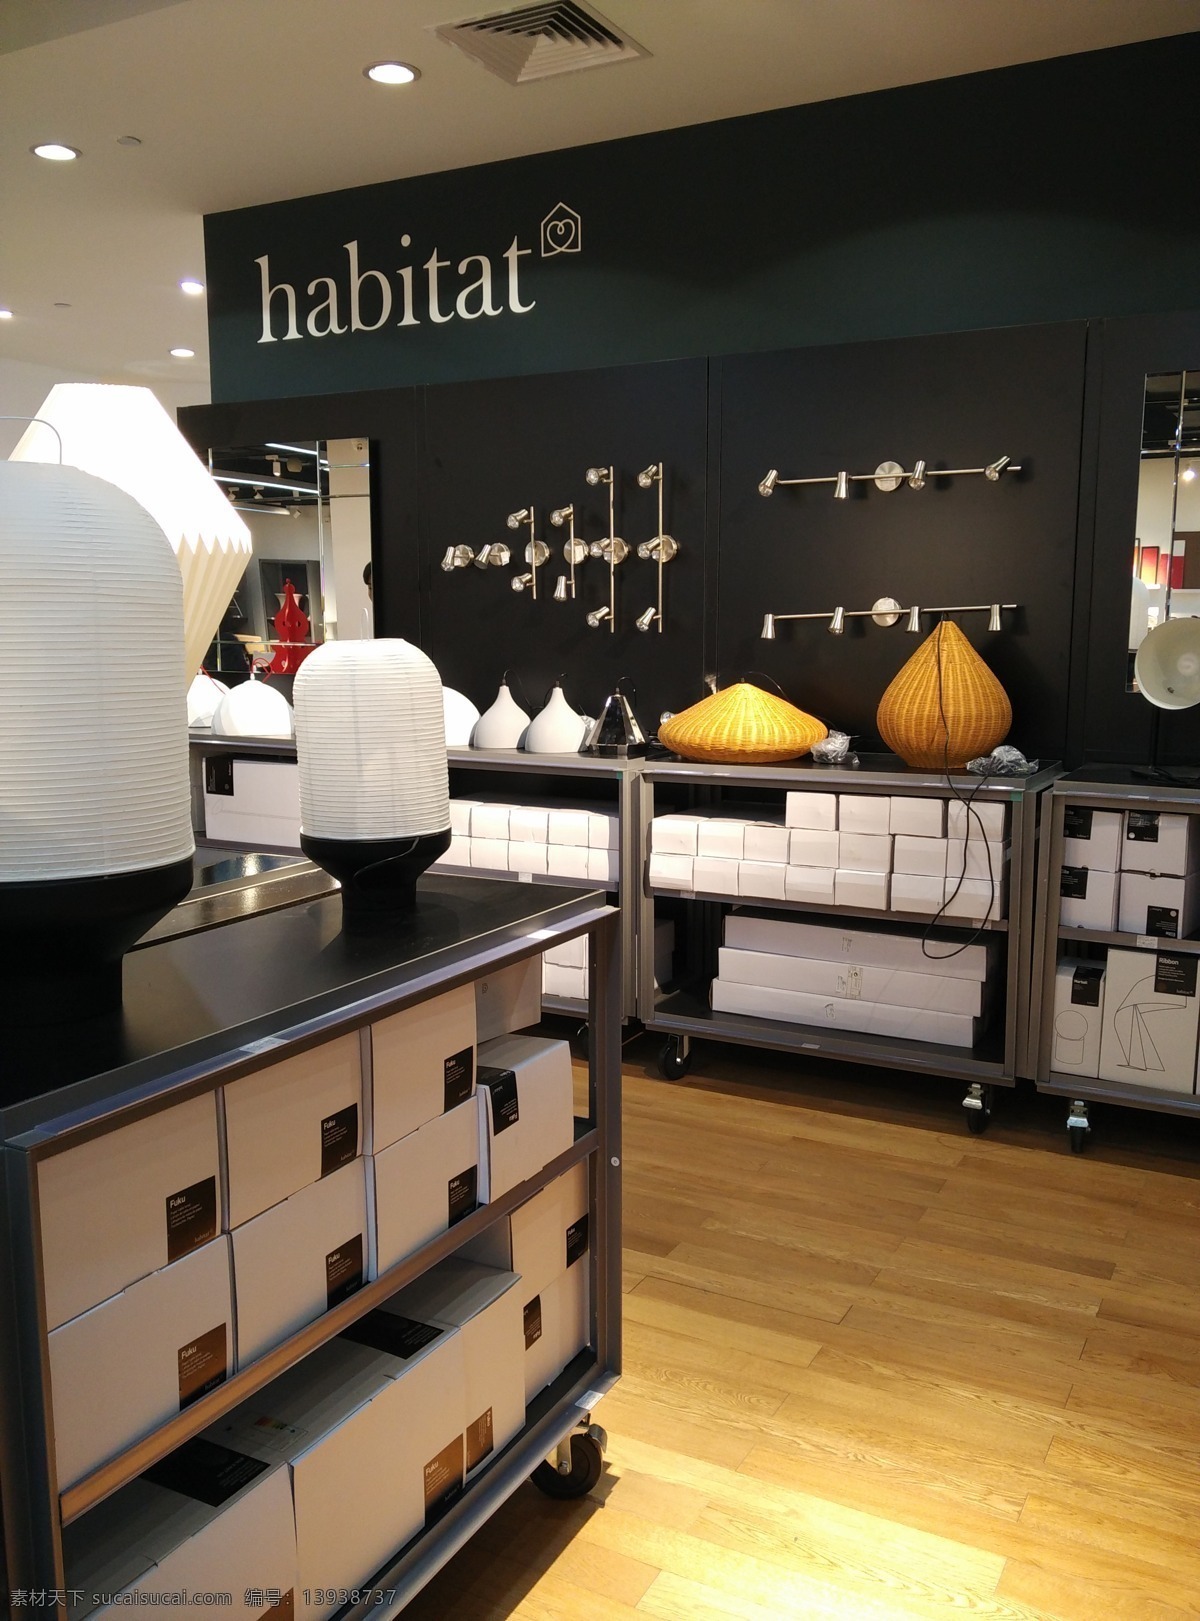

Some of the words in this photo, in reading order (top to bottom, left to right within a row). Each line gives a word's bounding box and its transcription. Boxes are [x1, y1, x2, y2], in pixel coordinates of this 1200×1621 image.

[254, 234, 536, 343] habitat
[1158, 957, 1179, 965] Ribbon
[169, 1196, 186, 1209] Fuku
[181, 1346, 197, 1360] Fuku
[425, 1461, 439, 1477] Fuku
